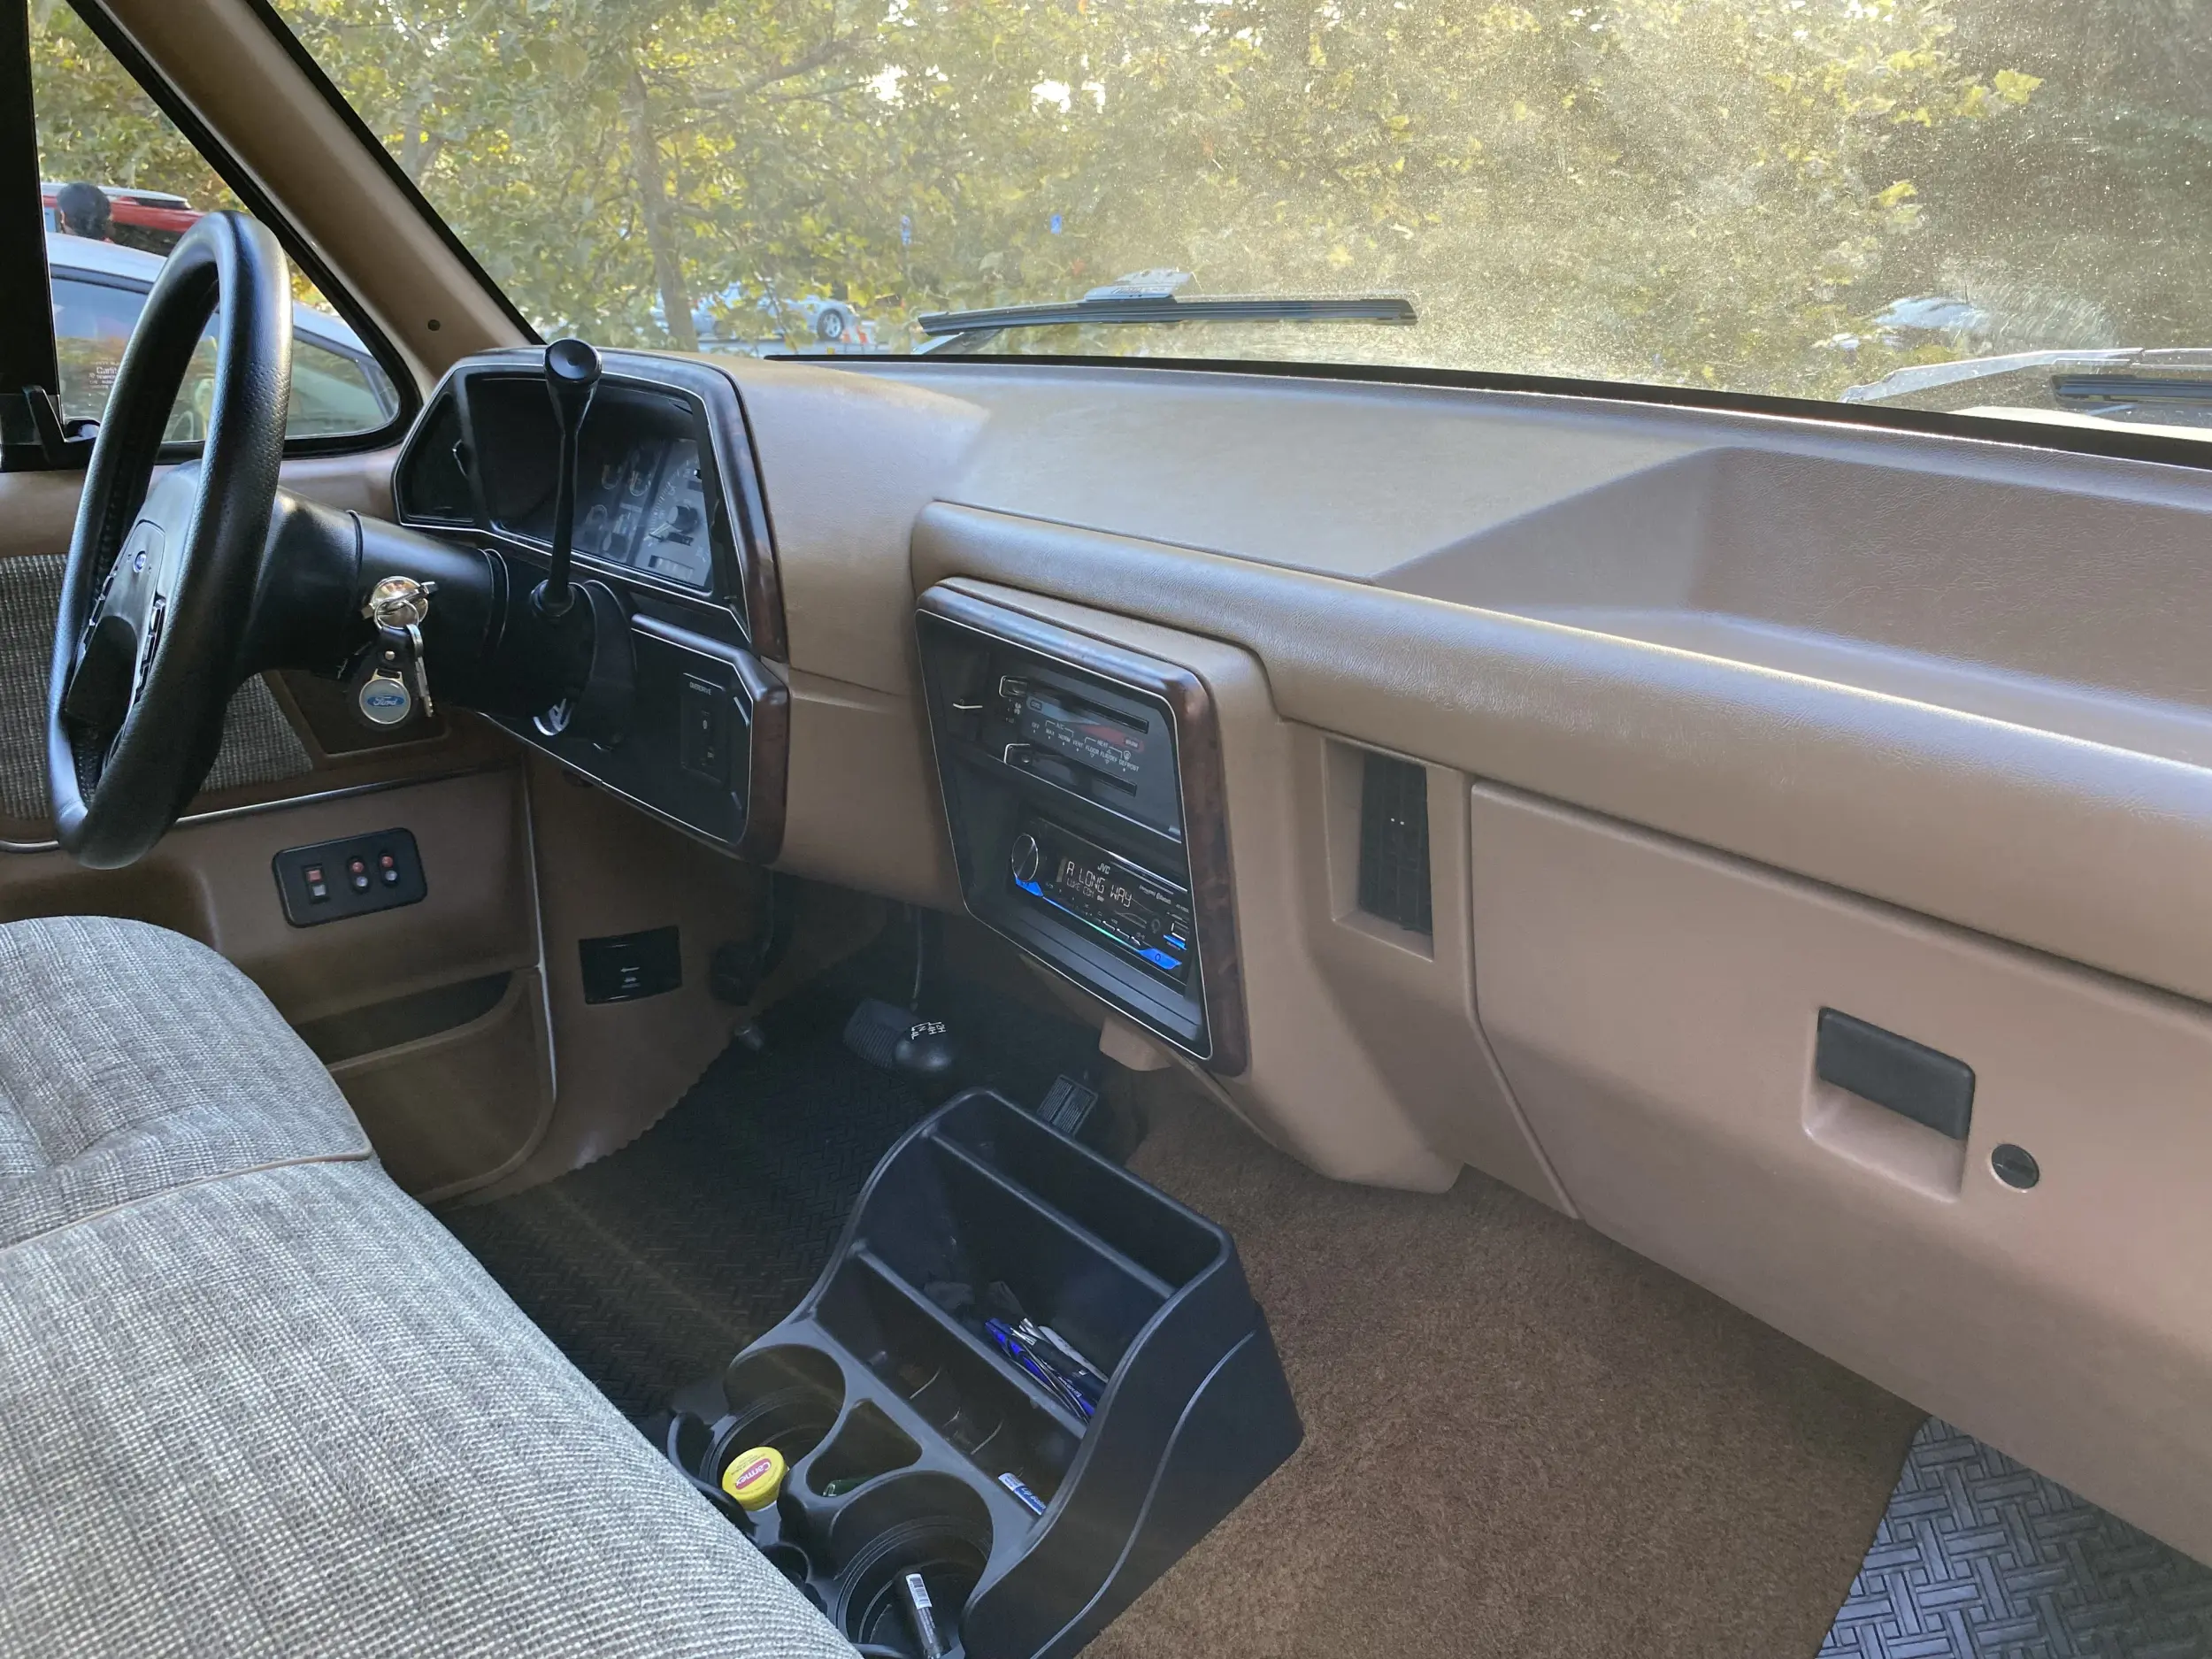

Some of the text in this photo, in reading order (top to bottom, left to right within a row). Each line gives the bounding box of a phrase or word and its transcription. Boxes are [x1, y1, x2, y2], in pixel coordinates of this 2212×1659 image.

[690, 681, 711, 695] OVERDRIVE
[373, 695, 398, 706] Ford
[1058, 733, 1071, 742] NORM
[1097, 740, 1109, 749] HEAT
[1085, 746, 1100, 756] FLOOR
[1118, 760, 1140, 772] DEFROST
[1097, 863, 1110, 875] JVC
[1066, 861, 1075, 876] A
[1079, 868, 1105, 894] LONG
[1110, 885, 1133, 908] WAY
[927, 1025, 938, 1035] 4H
[935, 1024, 946, 1033] 2H
[736, 1461, 772, 1486] Carmex
[1020, 1487, 1033, 1496] Lip
